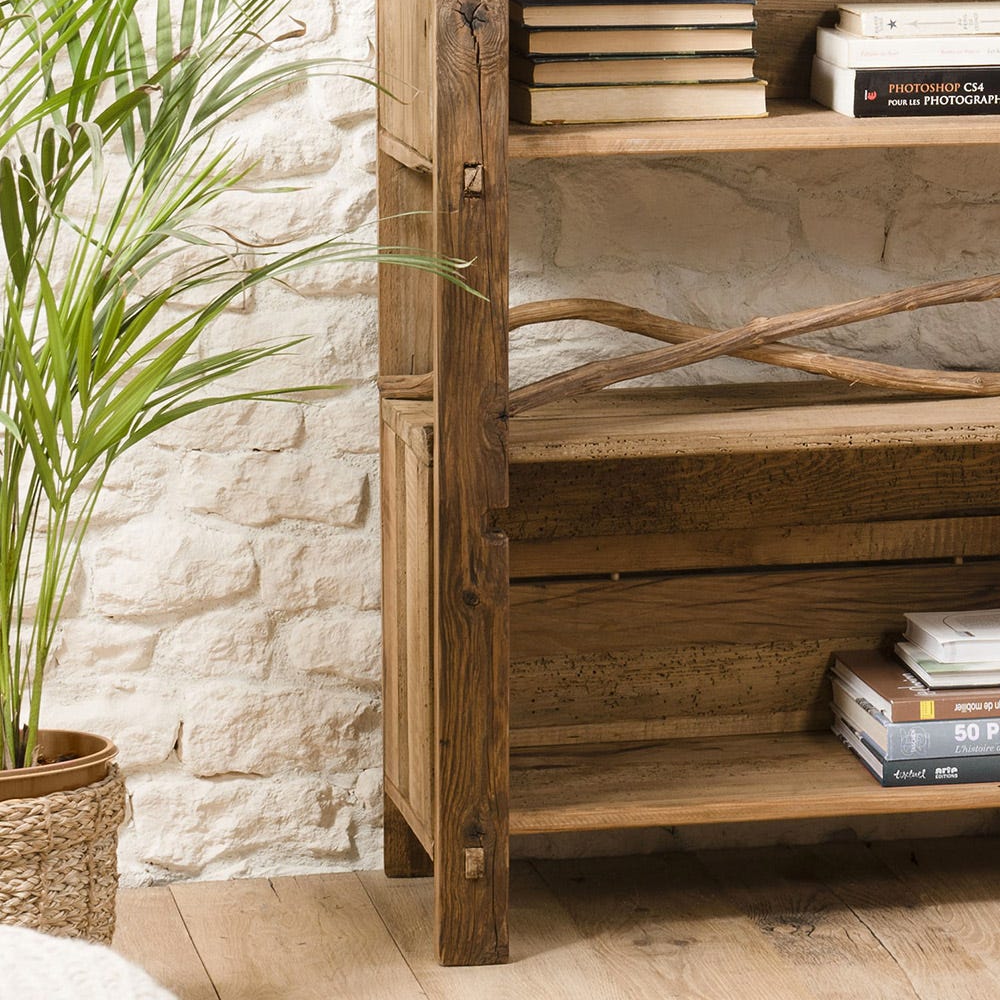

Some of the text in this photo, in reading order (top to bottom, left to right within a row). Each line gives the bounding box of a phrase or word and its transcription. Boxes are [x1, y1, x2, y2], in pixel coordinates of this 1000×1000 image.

[889, 82, 985, 93] PHOTOSHOP CS4
[954, 702, 982, 713] mobilier
[983, 701, 993, 712] de
[954, 723, 979, 742] 50
[954, 742, 995, 754] L'histoire
